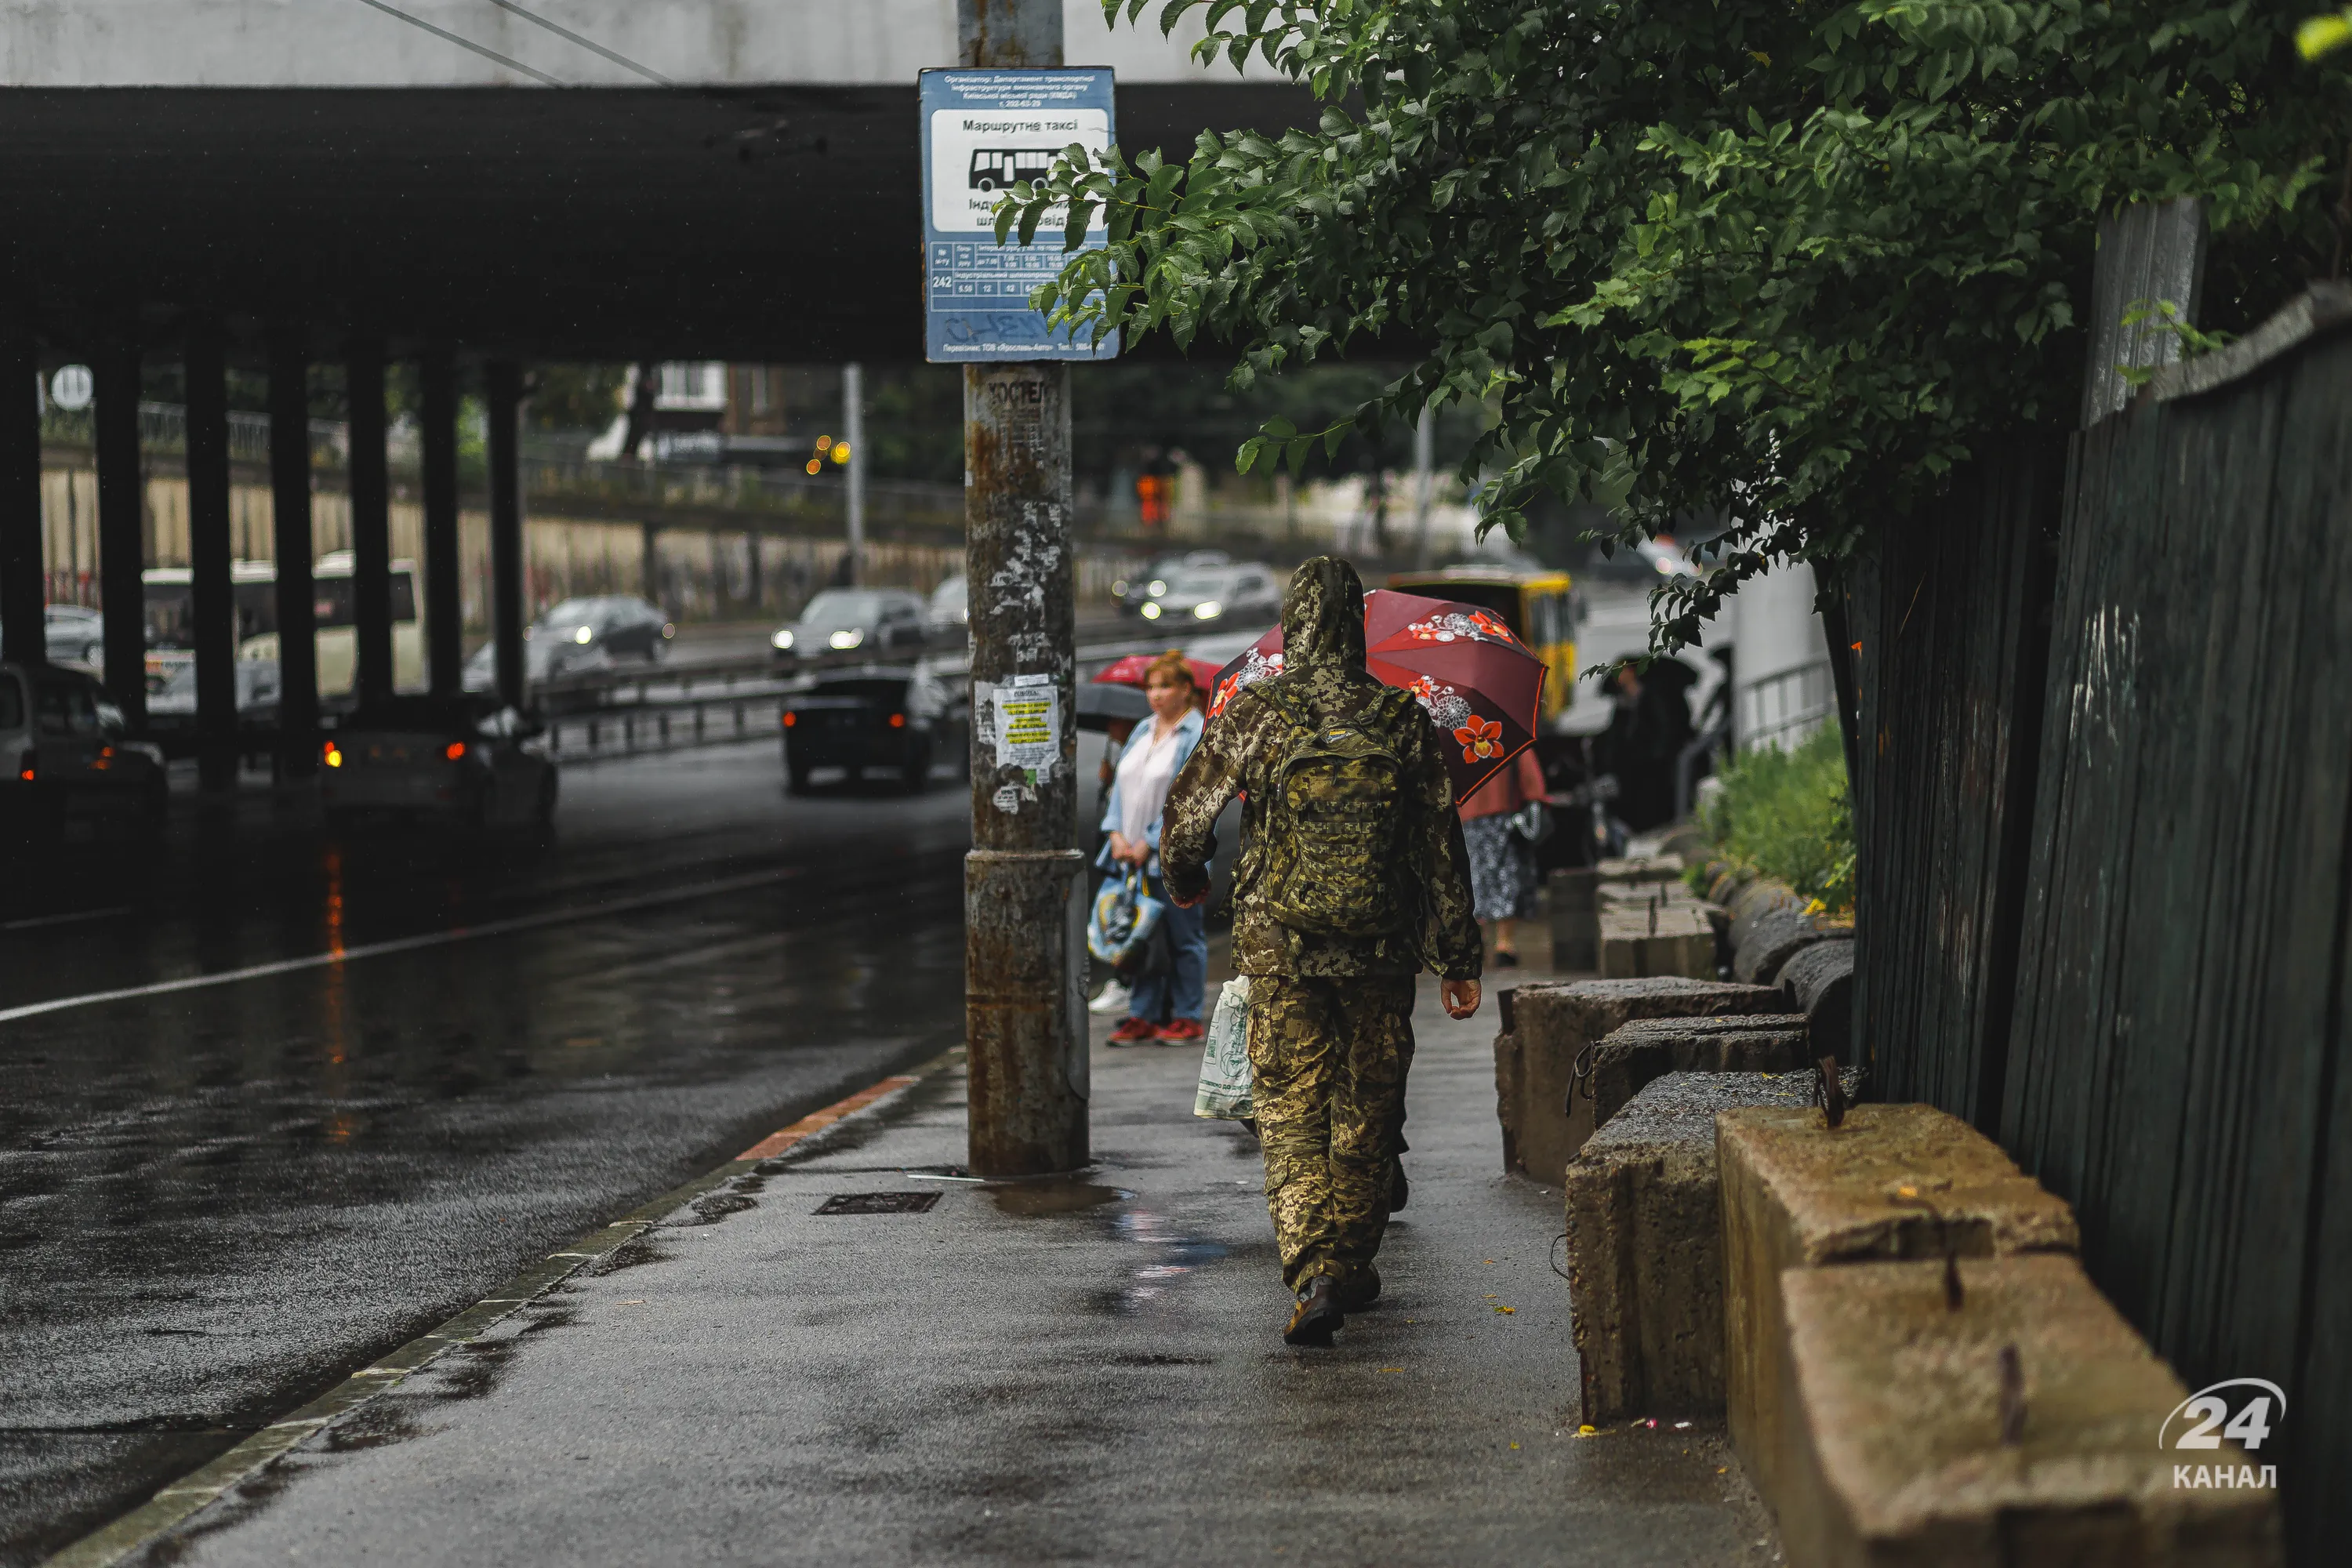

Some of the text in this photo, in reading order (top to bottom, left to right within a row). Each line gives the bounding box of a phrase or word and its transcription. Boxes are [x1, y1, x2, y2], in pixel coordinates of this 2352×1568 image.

[963, 119, 1078, 134] Маршрутне таксі
[933, 276, 952, 288] 242
